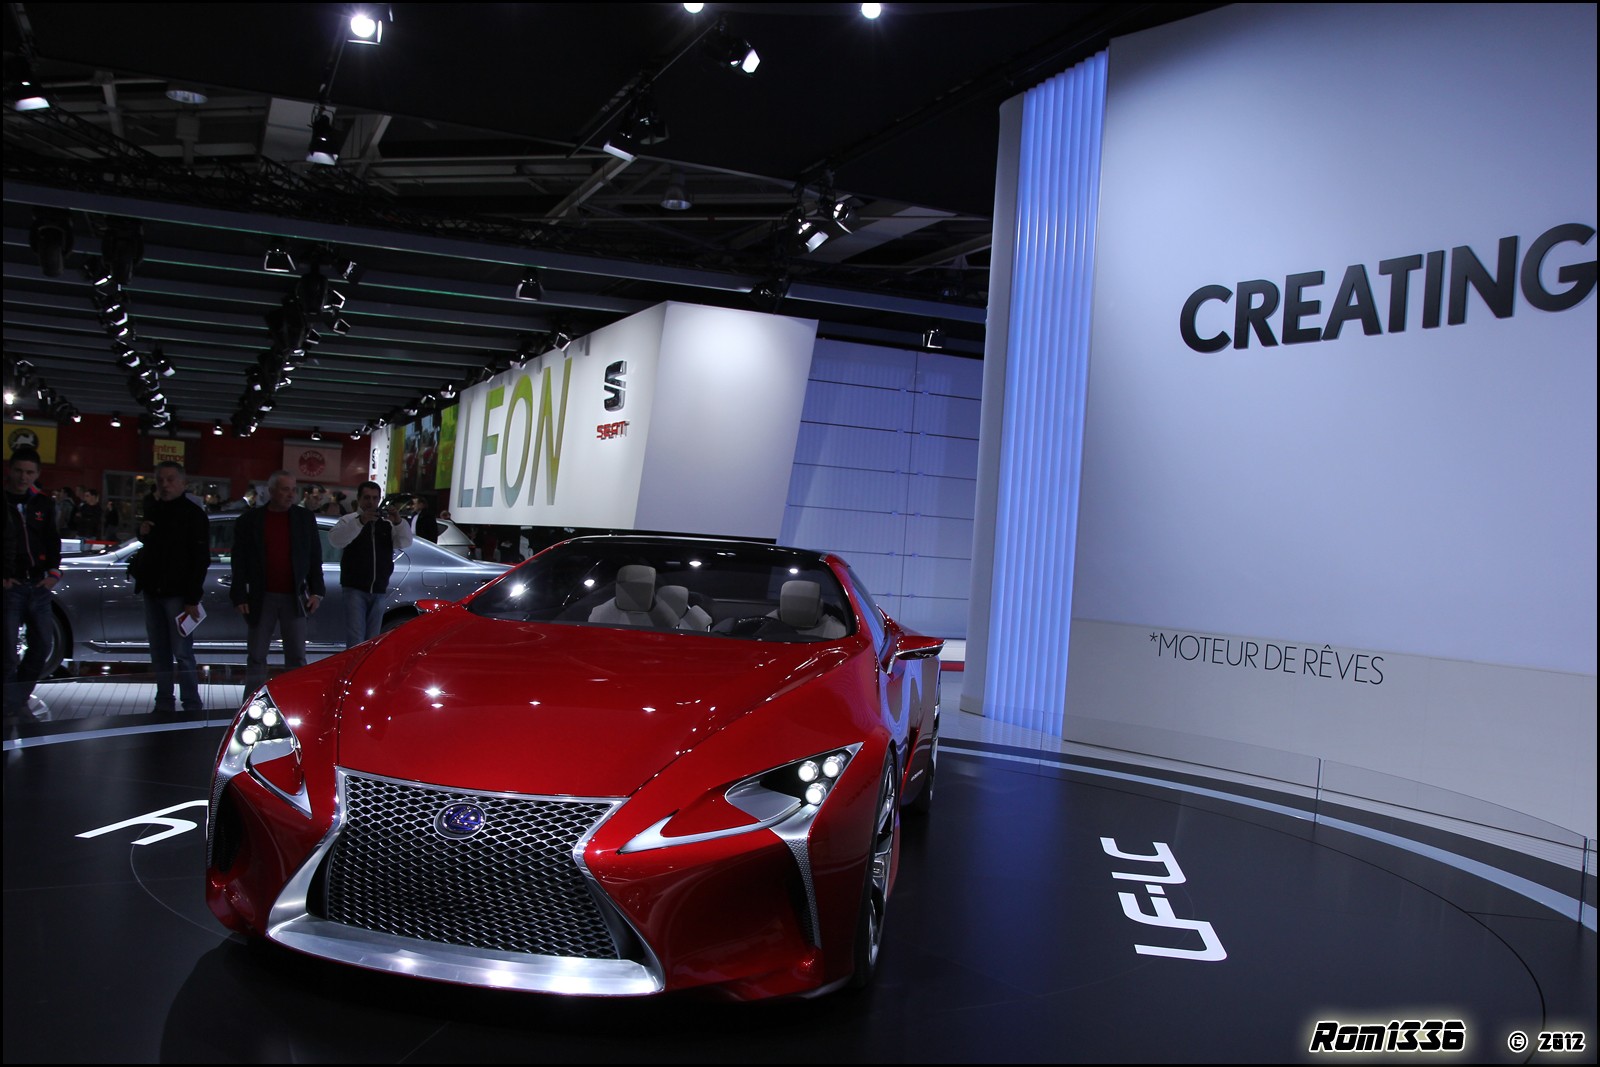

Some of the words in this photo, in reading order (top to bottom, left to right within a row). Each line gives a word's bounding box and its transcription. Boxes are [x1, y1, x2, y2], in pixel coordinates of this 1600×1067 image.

[1180, 223, 1597, 354] CREATING
[457, 357, 572, 509] LEON
[597, 421, 630, 440] SEAT
[1264, 644, 1297, 673] DE
[1303, 644, 1384, 685] RÊVES
